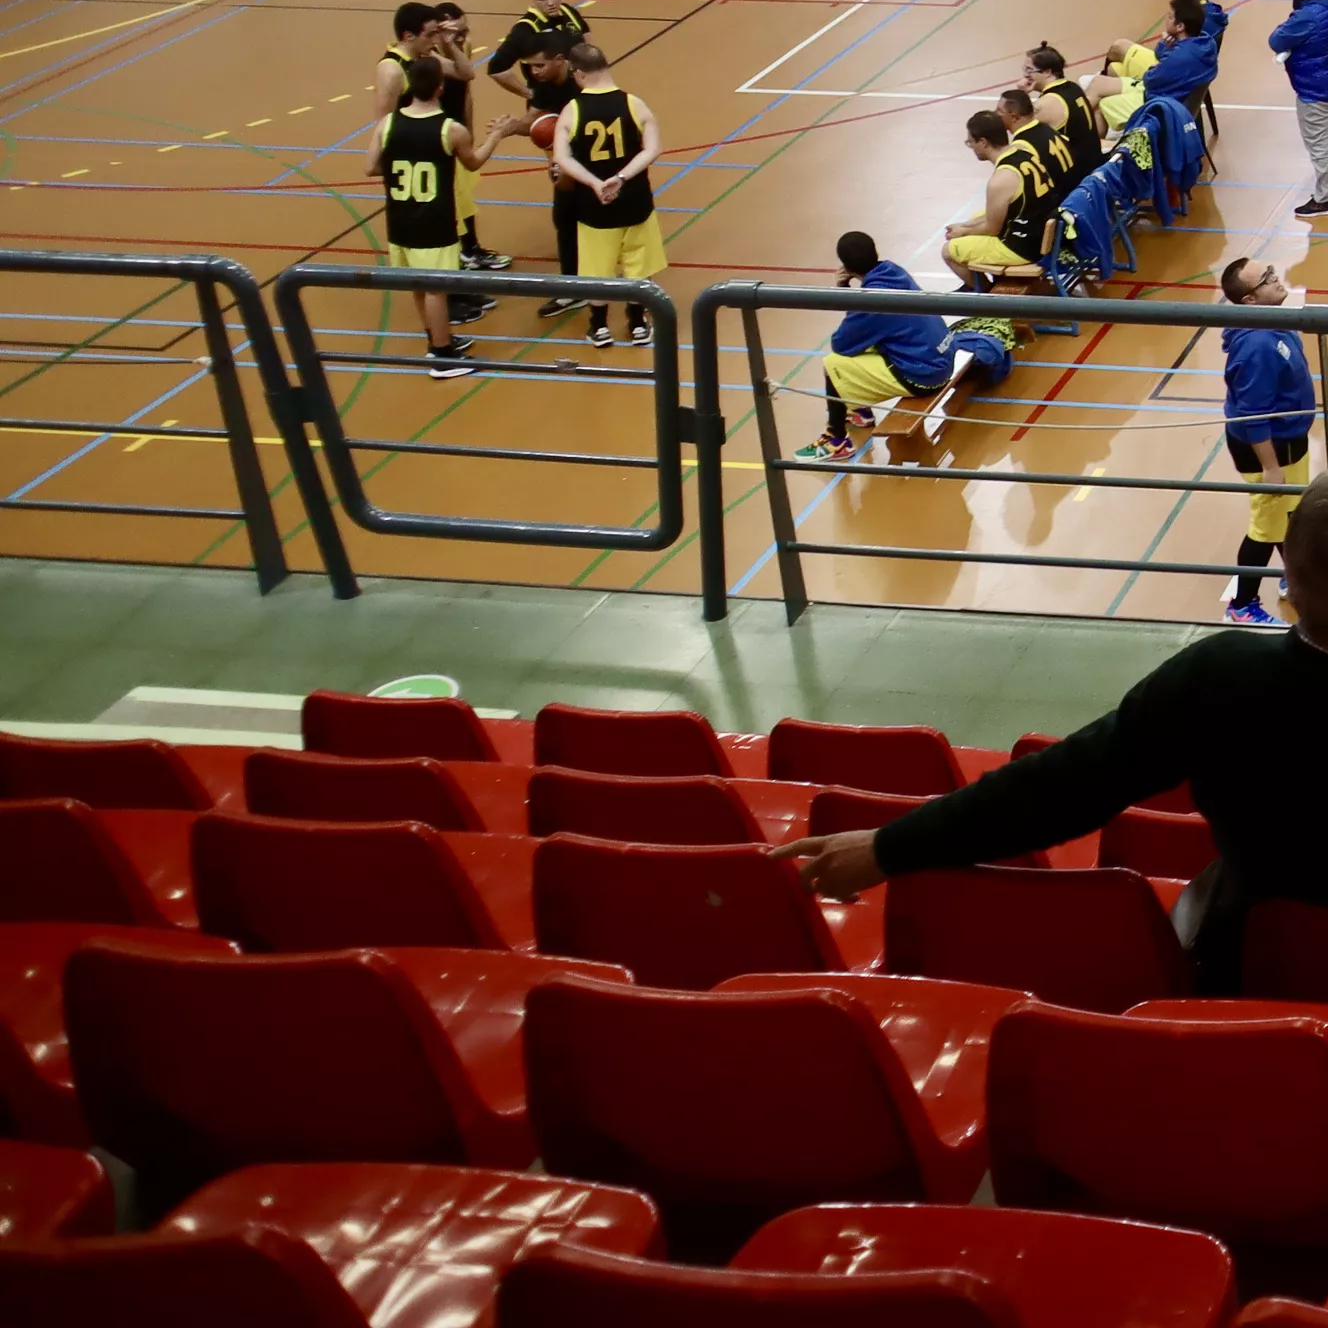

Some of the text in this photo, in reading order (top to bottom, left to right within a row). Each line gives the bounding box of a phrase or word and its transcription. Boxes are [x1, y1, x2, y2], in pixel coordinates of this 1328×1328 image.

[584, 116, 626, 162] 21
[1048, 135, 1074, 173] 11
[390, 160, 438, 203] 30
